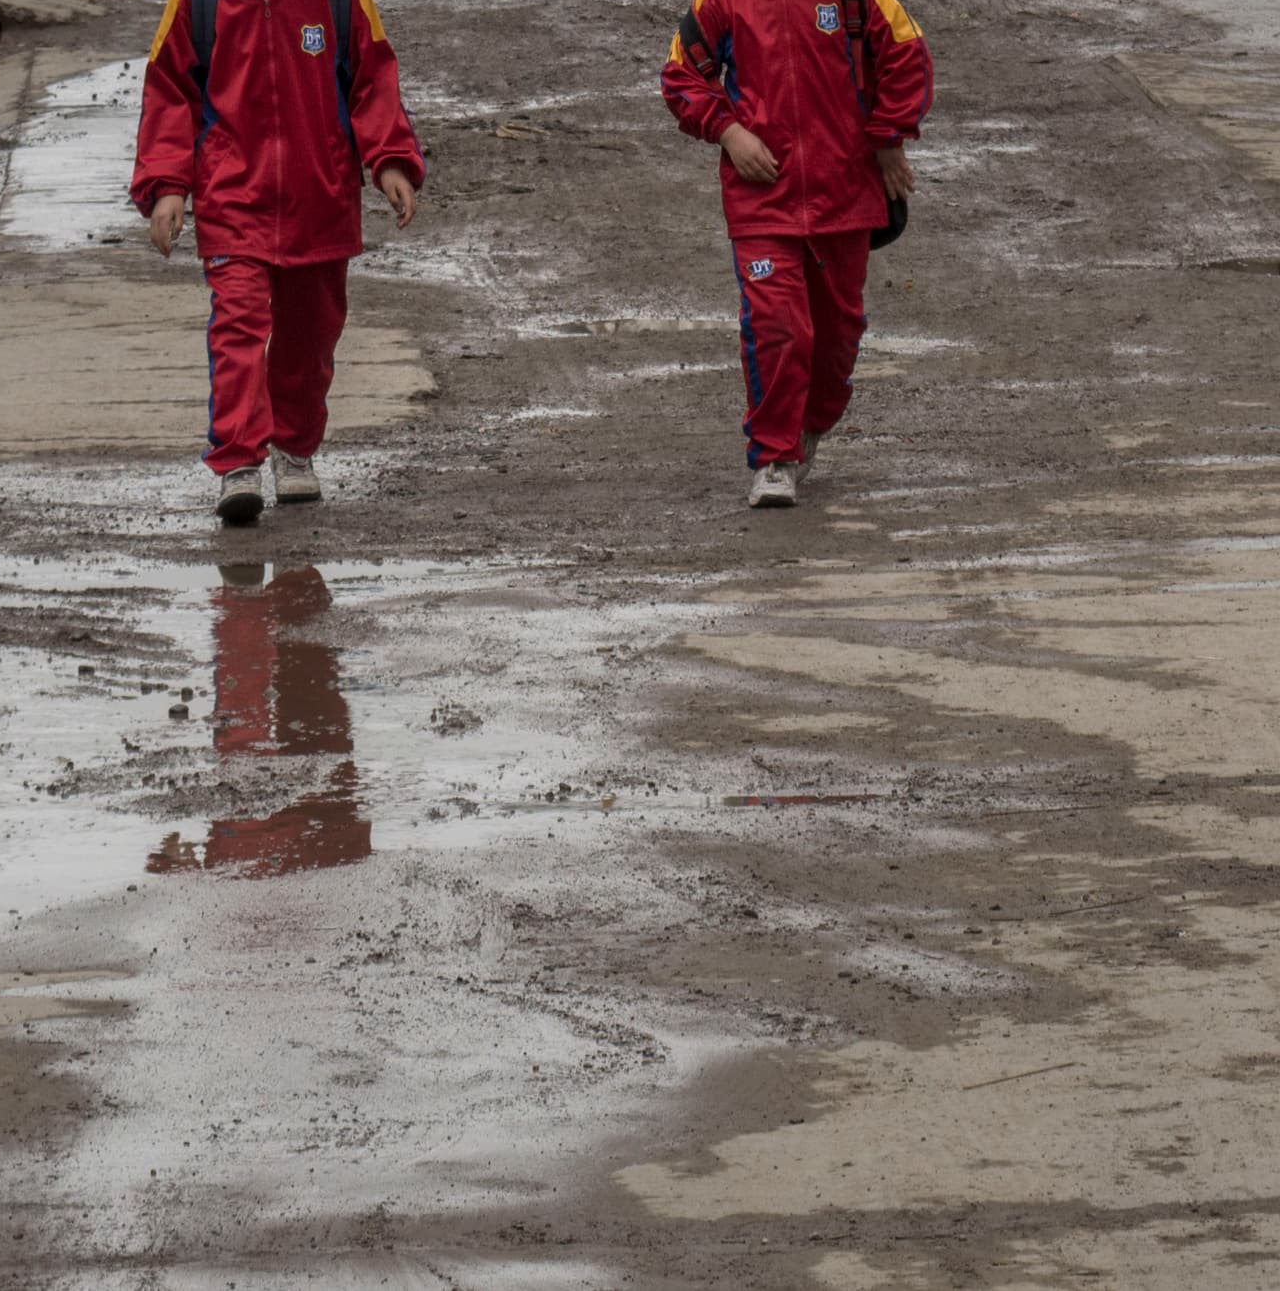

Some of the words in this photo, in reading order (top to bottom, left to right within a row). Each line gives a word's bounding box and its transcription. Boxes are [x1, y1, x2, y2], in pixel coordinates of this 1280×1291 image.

[820, 11, 836, 24] DT
[305, 33, 321, 47] DT
[751, 258, 770, 274] DT
